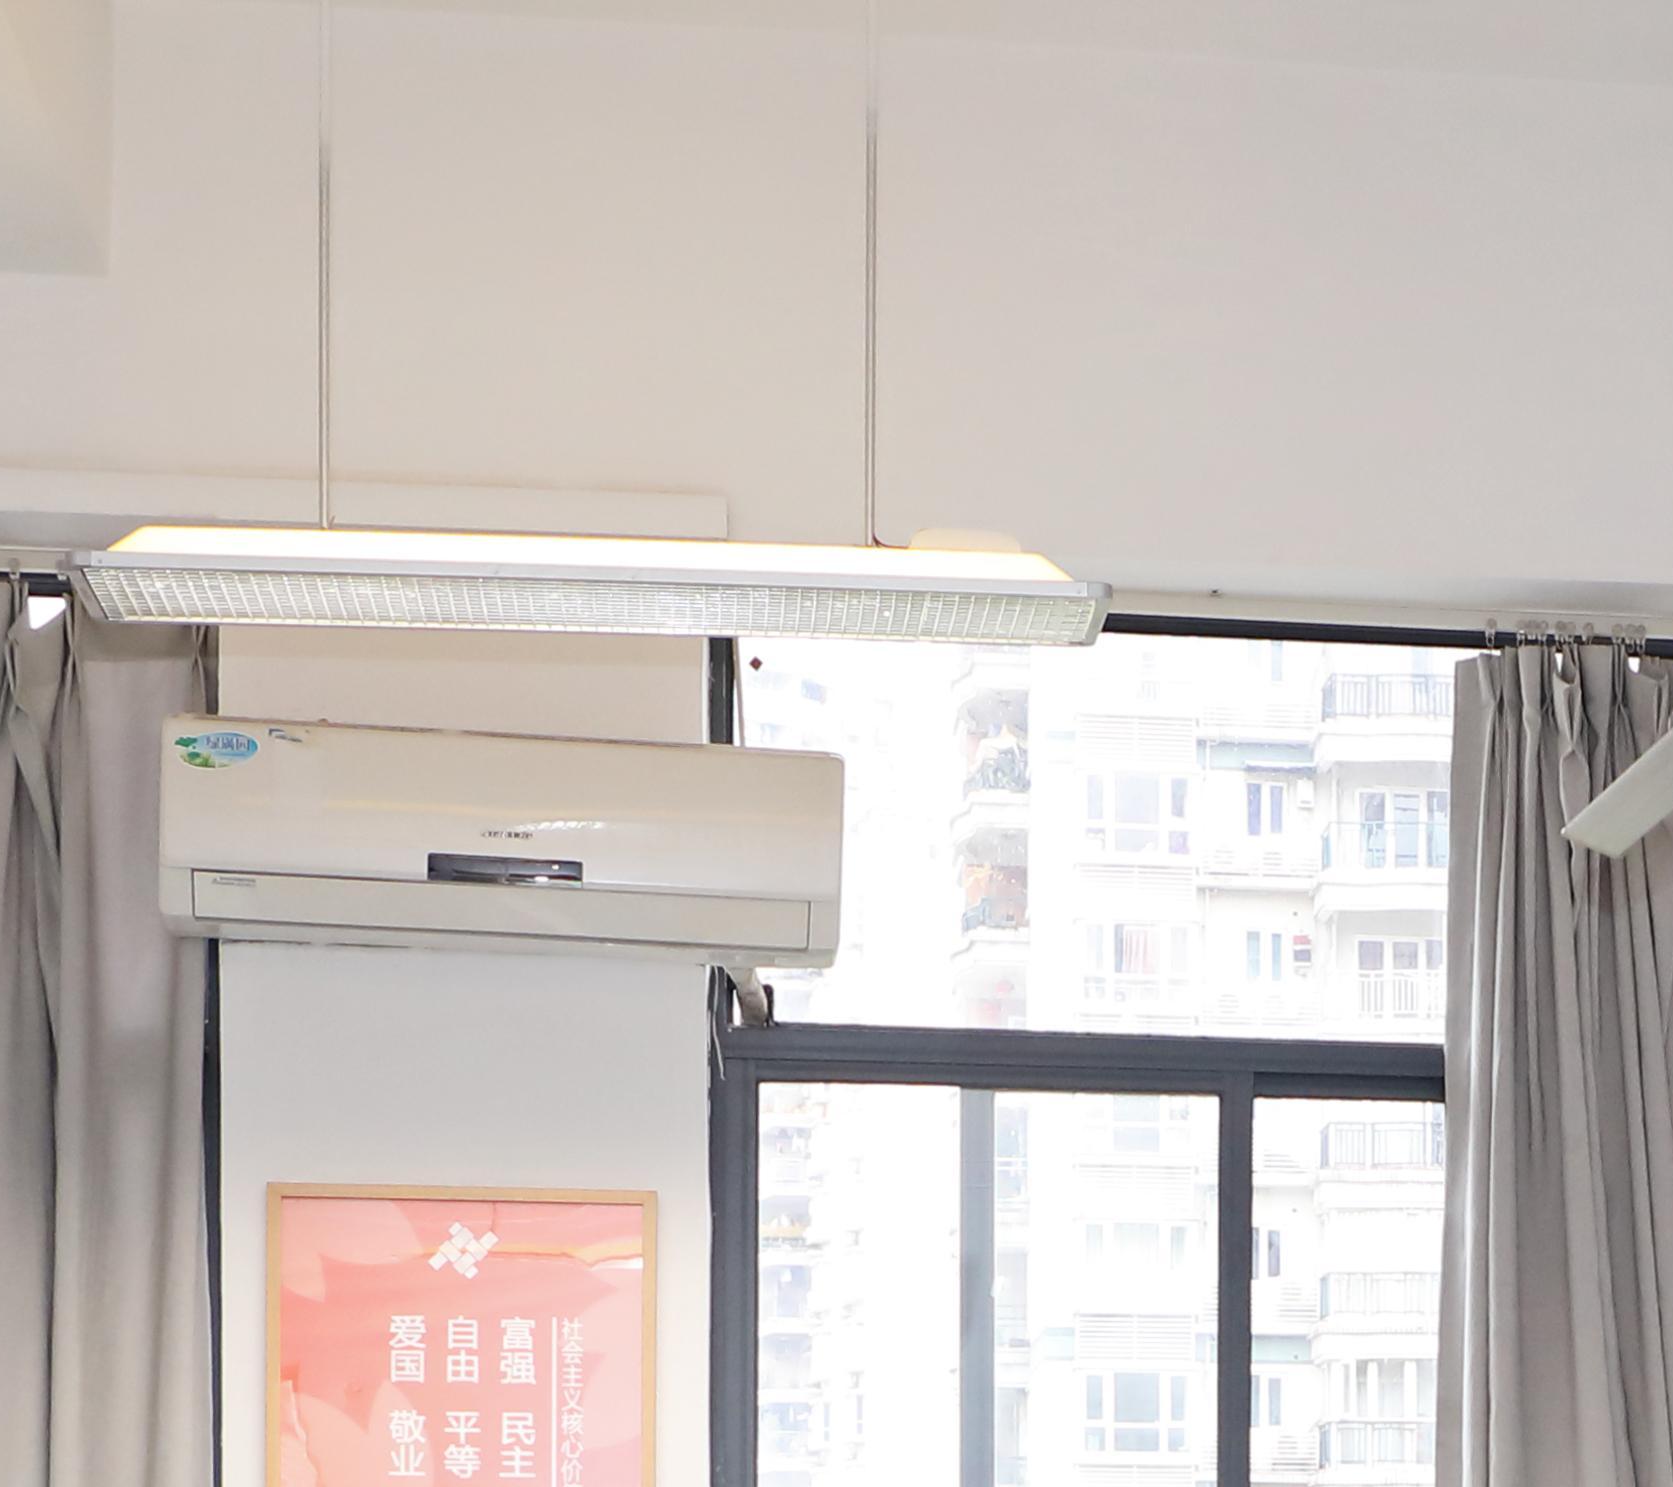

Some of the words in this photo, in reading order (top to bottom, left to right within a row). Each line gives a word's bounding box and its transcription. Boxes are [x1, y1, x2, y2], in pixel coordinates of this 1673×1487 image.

[388, 1315, 426, 1384] 爱国
[443, 1316, 480, 1385] 自由
[499, 1316, 536, 1385] 富强
[388, 1410, 426, 1478] 敬业
[443, 1410, 481, 1479] 平等
[499, 1411, 536, 1480] 民主
